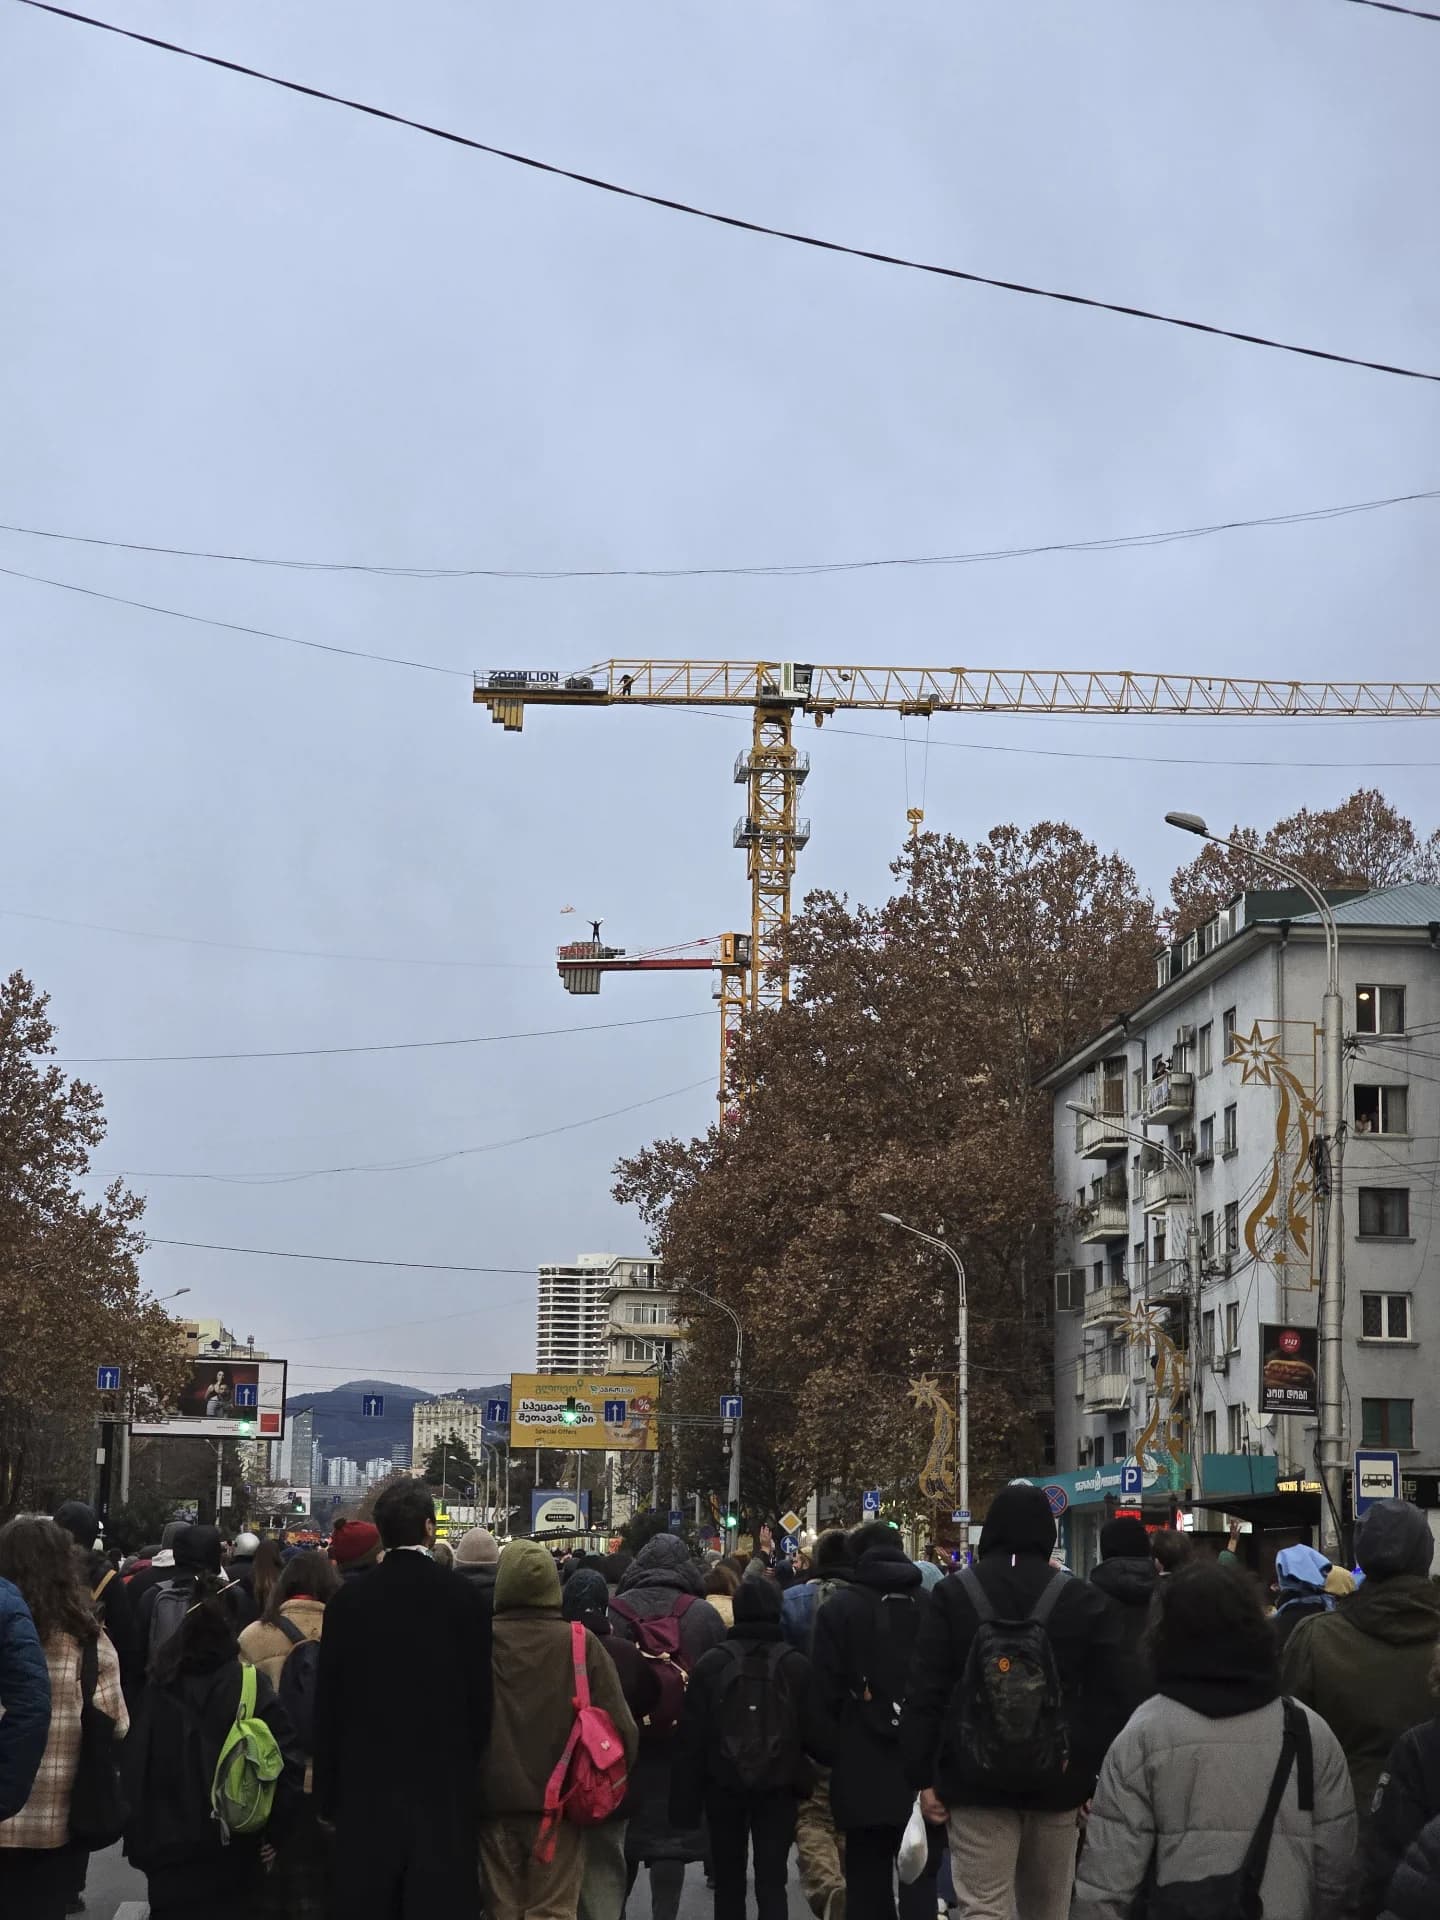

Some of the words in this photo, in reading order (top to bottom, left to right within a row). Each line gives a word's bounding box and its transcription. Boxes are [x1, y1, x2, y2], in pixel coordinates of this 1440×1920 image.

[489, 671, 559, 682] ZOOMLION
[522, 1401, 591, 1412] სპეციალრი
[518, 1413, 594, 1424] შეთავაზები
[1125, 1469, 1137, 1491] P
